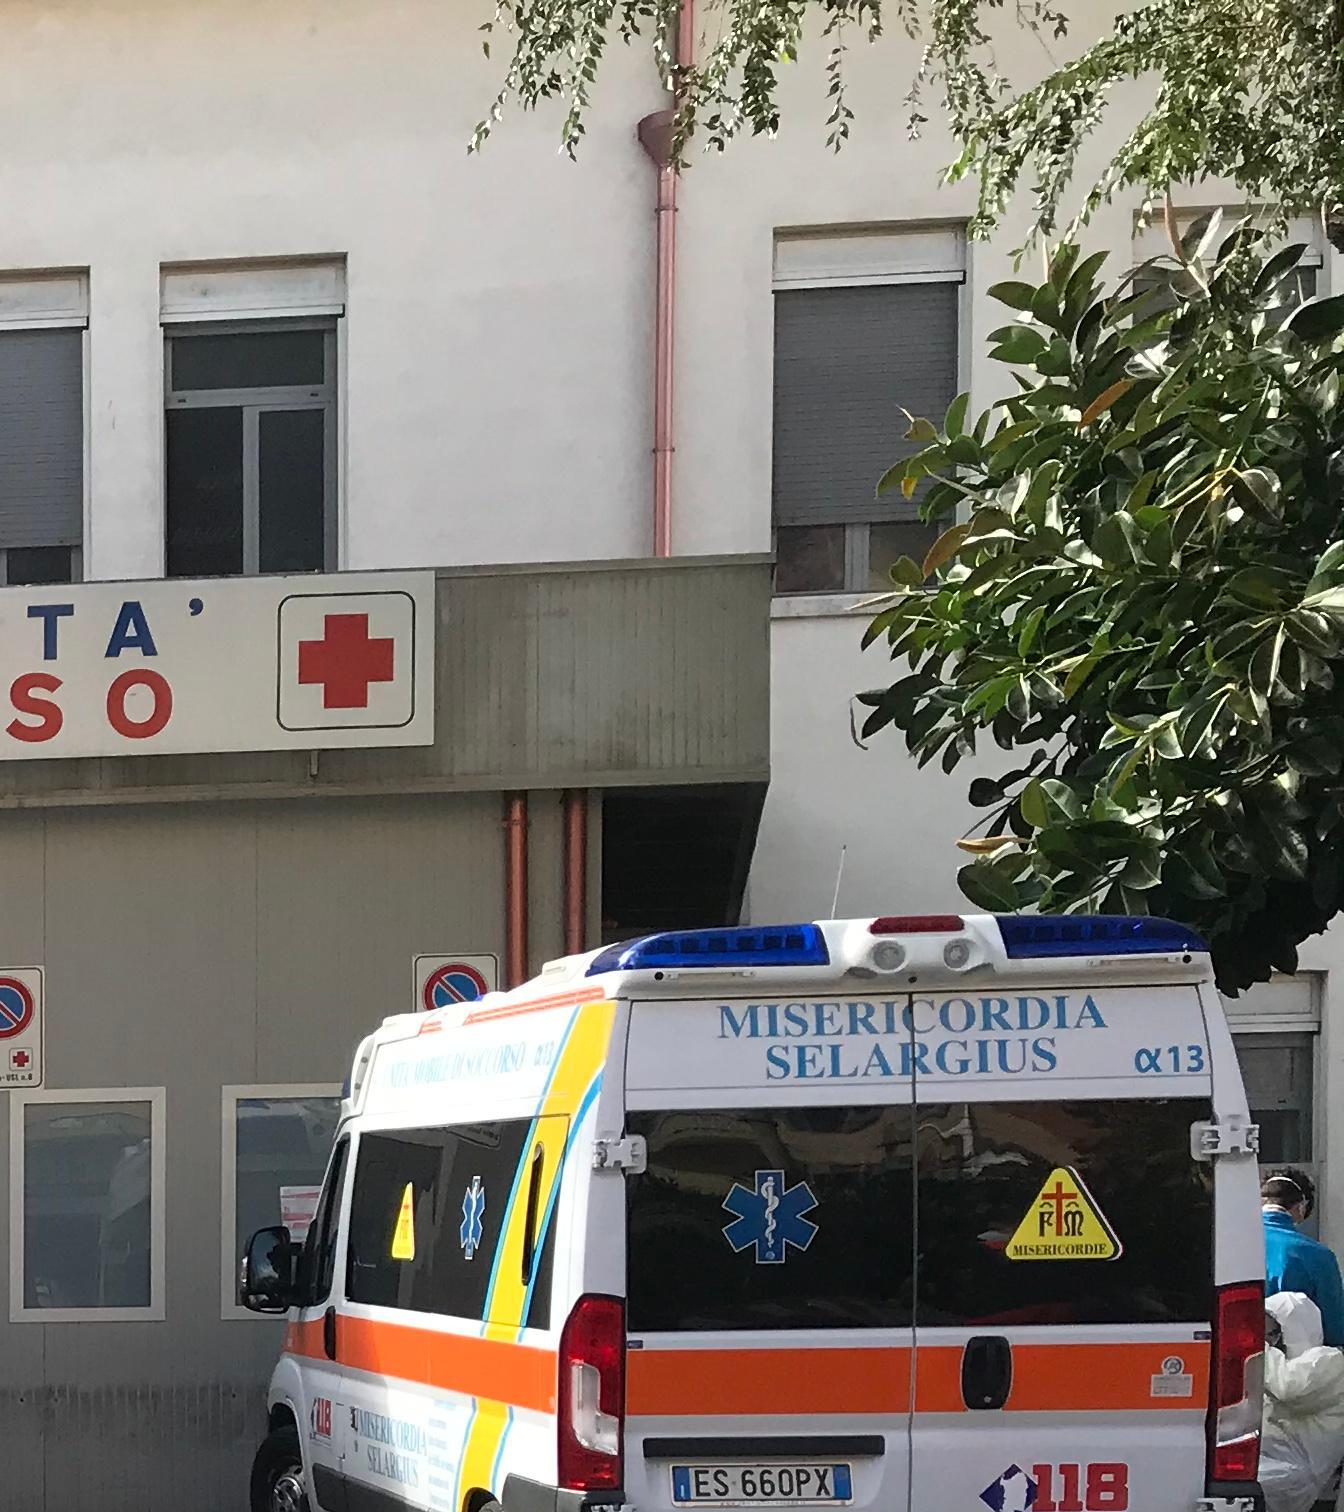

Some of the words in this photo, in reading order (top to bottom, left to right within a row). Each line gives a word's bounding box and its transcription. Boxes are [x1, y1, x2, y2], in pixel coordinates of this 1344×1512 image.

[716, 994, 1108, 1039] MISERICORDIA
[765, 1036, 1058, 1081] SELARGIUS
[1012, 1243, 1109, 1256] MISERICORDIE
[357, 1407, 428, 1457] MISERICORDIA
[367, 1444, 418, 1488] SELARGIUS
[694, 1469, 730, 1497] ES
[740, 1468, 831, 1497] 660PX
[1031, 1462, 1129, 1512] 118
